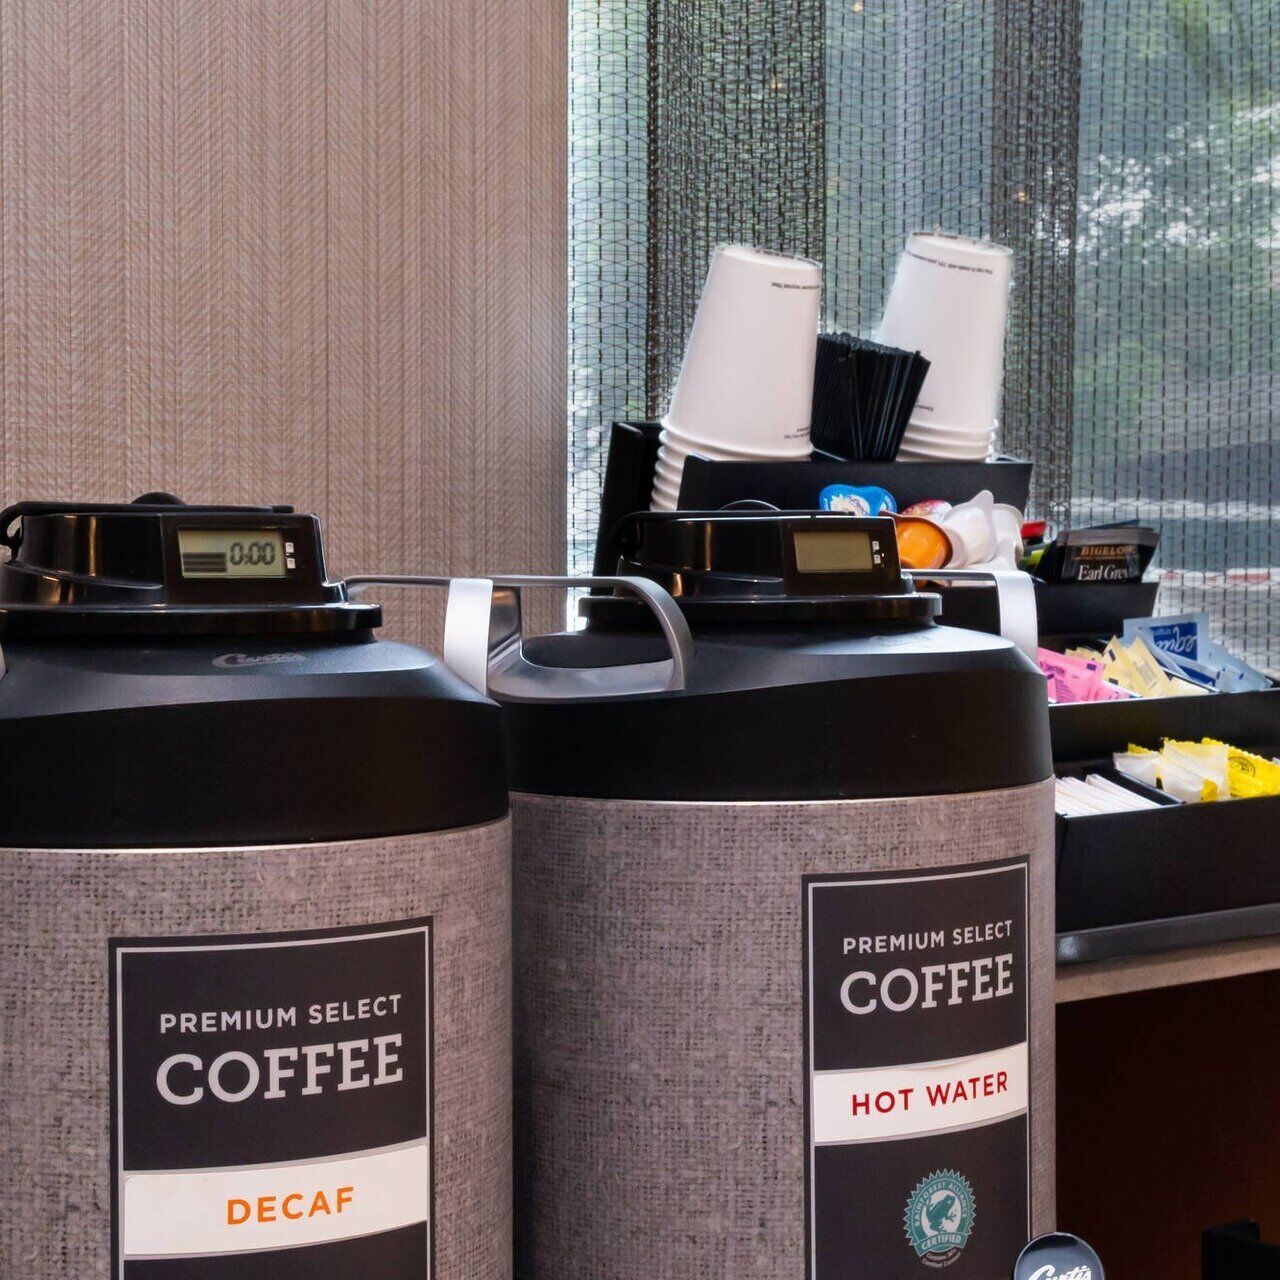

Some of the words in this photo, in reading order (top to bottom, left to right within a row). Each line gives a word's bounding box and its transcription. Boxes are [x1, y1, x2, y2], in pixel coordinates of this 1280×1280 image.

[1078, 565, 1103, 581] Earl
[843, 930, 945, 955] PREMIUM
[952, 919, 1013, 946] SELECT
[840, 952, 1014, 1016] COFFEE
[159, 1007, 297, 1034] PREMIUM
[308, 993, 402, 1025] SELECT
[155, 1033, 403, 1106] COFFEE
[851, 1087, 914, 1117] HOT
[926, 1070, 1009, 1106] WATER
[226, 1186, 354, 1226] DECAF
